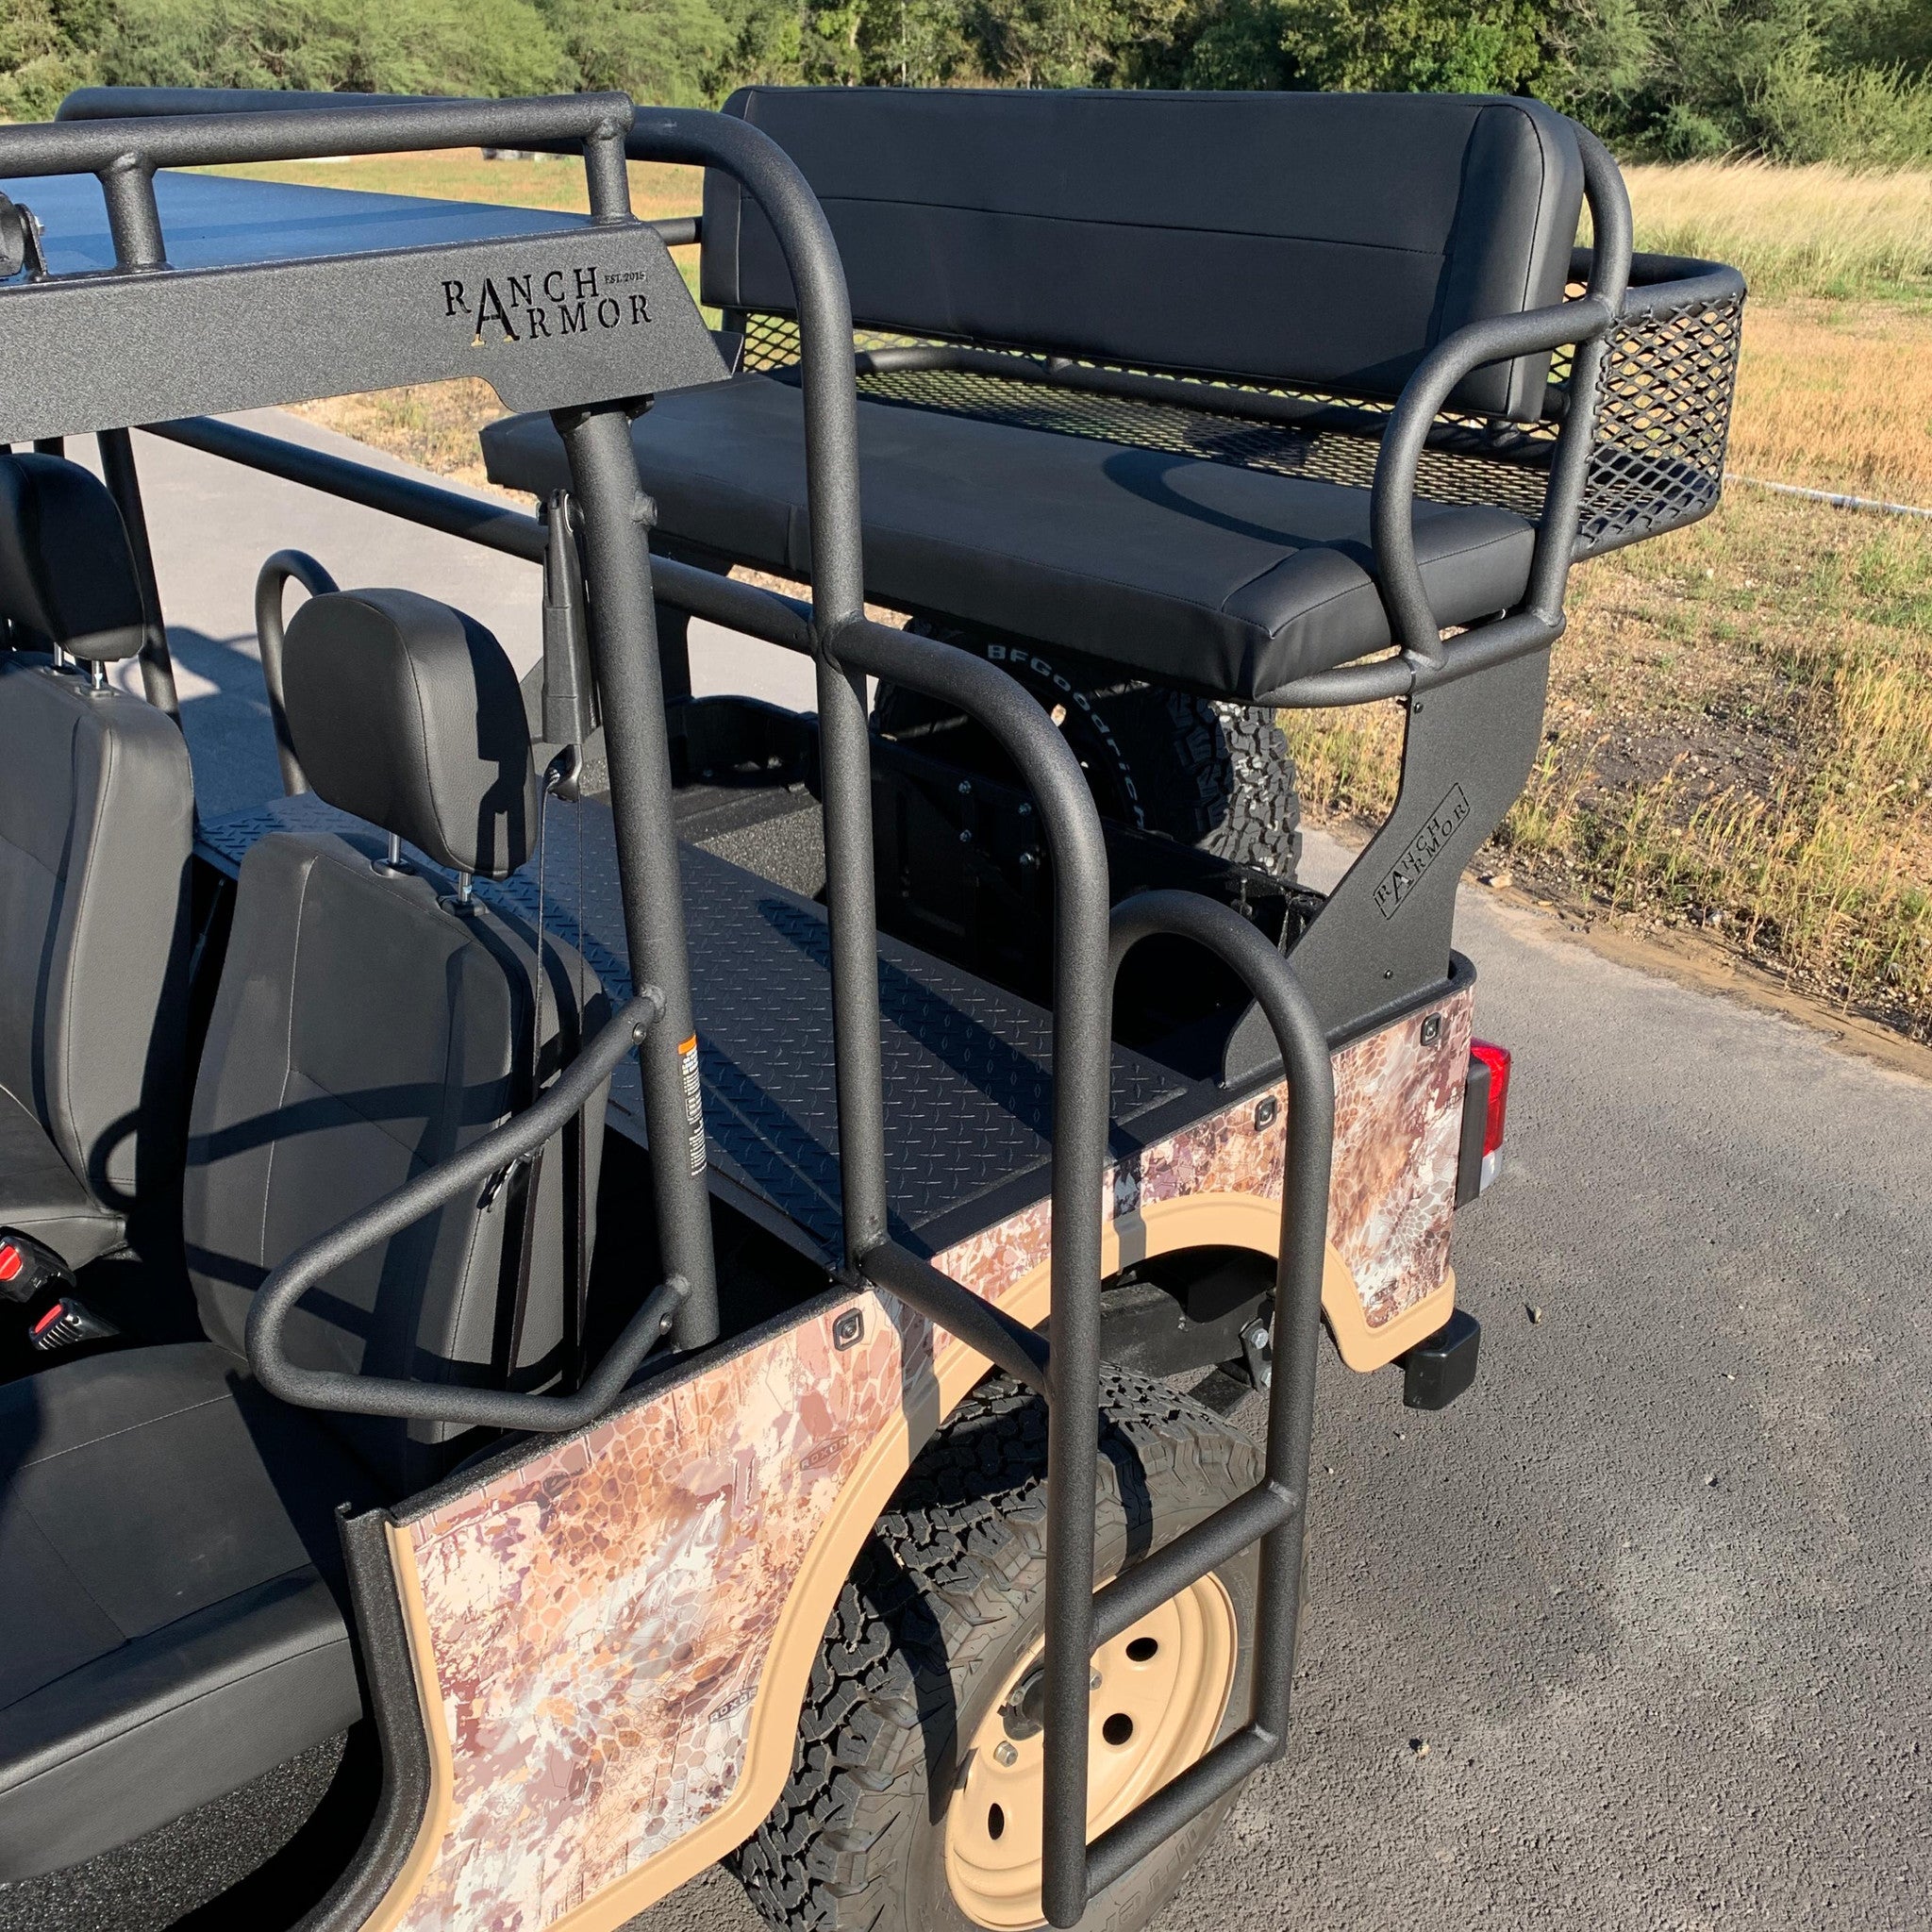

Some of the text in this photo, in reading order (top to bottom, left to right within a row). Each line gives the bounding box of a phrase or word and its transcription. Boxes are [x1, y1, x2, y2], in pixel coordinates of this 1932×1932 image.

[441, 267, 600, 347] RANCH
[471, 277, 653, 347] ARMOR
[1375, 816, 1441, 905] RANCH
[1392, 804, 1467, 905] ARMOR
[800, 1437, 848, 1470] ROXOR
[709, 1688, 758, 1723] ROXOR
